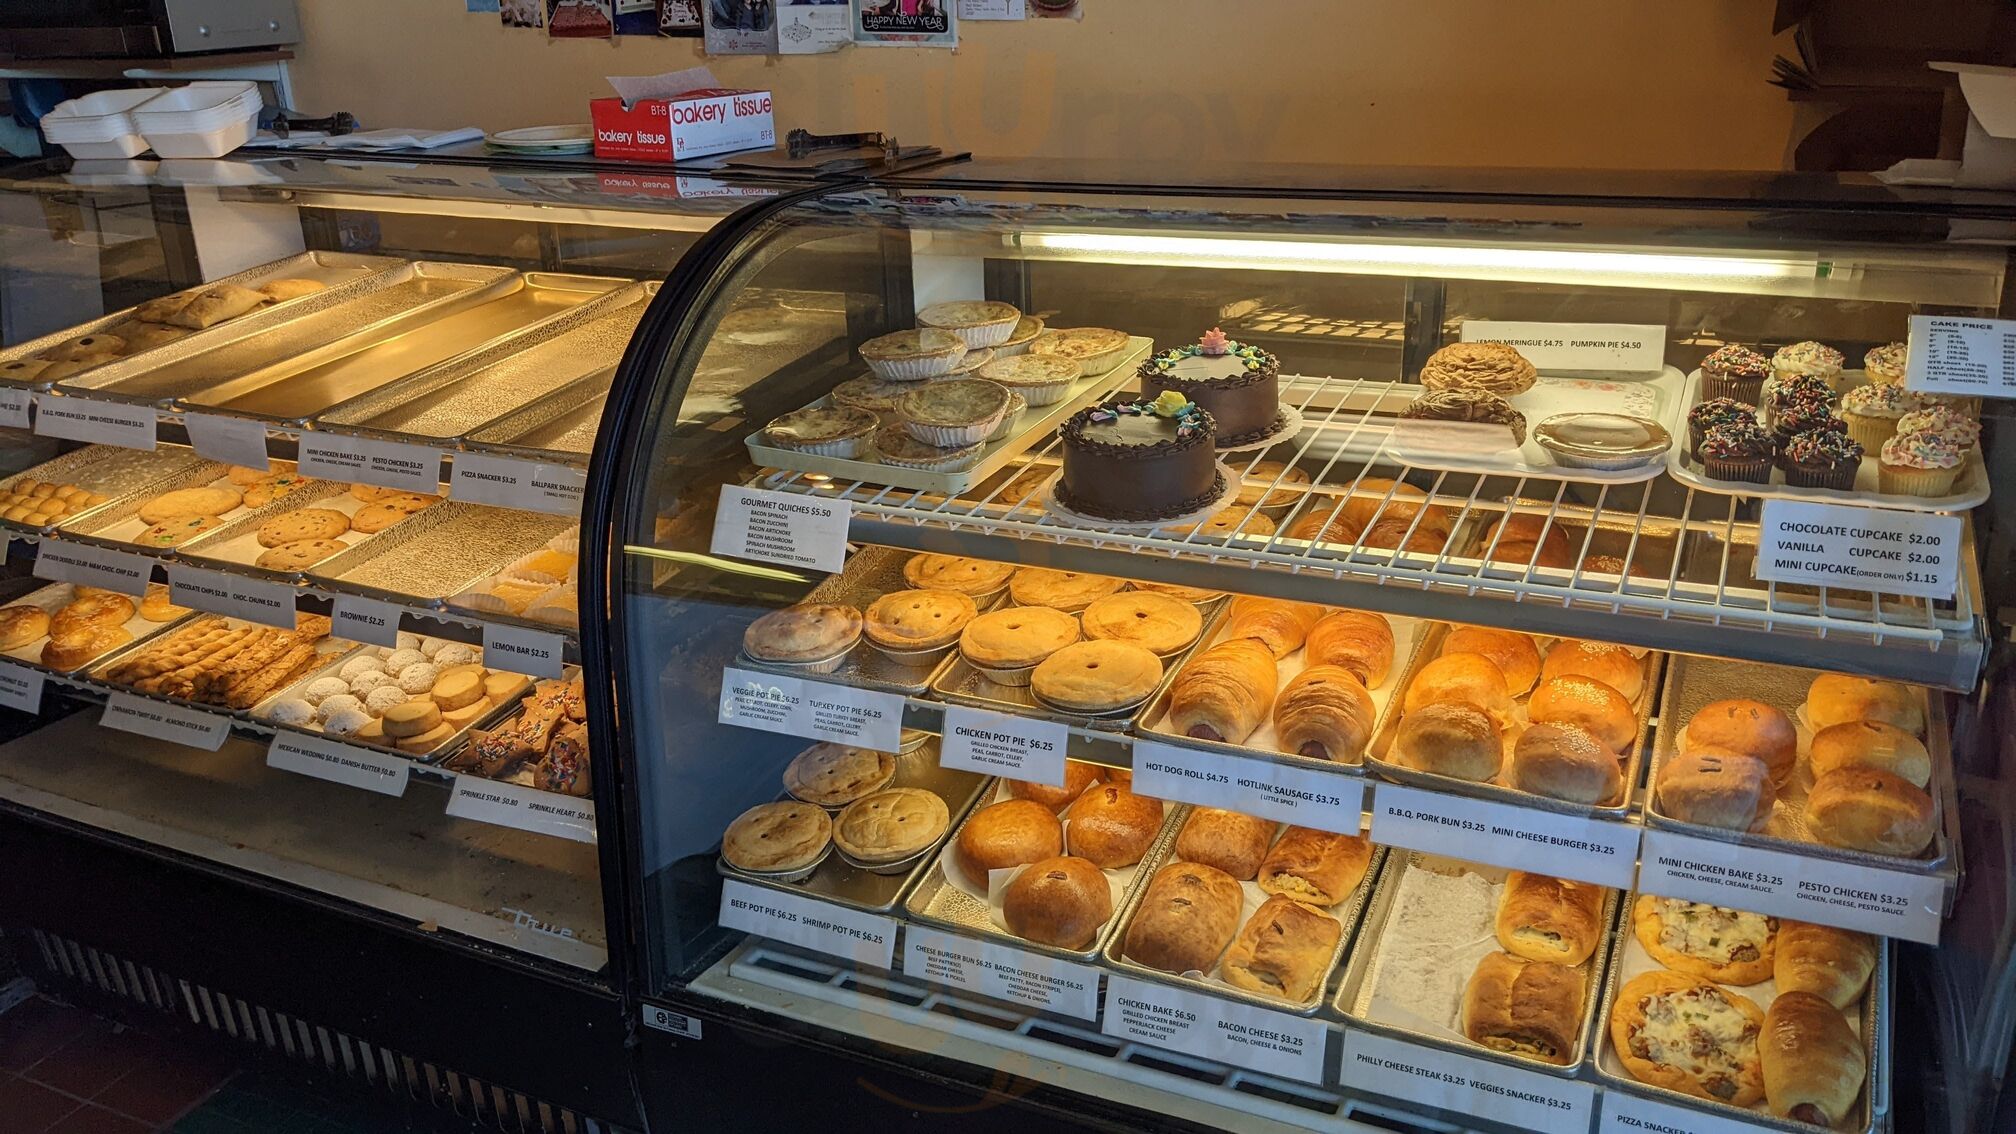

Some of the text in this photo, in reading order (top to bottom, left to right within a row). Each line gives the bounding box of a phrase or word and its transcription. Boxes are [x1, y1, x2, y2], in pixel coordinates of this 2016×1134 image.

[865, 16, 894, 27] HAPPY
[896, 14, 917, 25] NEW
[919, 16, 943, 27] YEAR
[651, 105, 666, 116] BT-8
[672, 96, 771, 124] bakery tissue
[598, 129, 665, 145] bakery tissue
[761, 130, 773, 141] BT-8
[1503, 339, 1542, 347] MERINGUE
[1620, 341, 1641, 349] $4.50
[319, 450, 339, 458] CHICKEN
[388, 459, 409, 467] CHICKEN
[477, 473, 501, 482] SNACKER
[502, 476, 516, 484] $3.25
[531, 481, 558, 490] BALLPARK
[741, 498, 831, 517] GOURMET QUICHES $5.50
[767, 512, 788, 520] SPINACH
[765, 527, 791, 536] ARTICHOKE
[767, 519, 788, 528] ZUCCHINI
[765, 535, 793, 544] MUSHROOM
[1780, 522, 1940, 546] CHOCOLATE CUPCAKE $2.00
[746, 540, 795, 552] SPINACH MUSHROOM
[1777, 541, 1940, 565] VANILLA CUPCAKE $2.00
[745, 548, 769, 556] ARTICHOKE
[795, 555, 816, 563] TOMATO
[1775, 559, 1801, 570] MINI
[1906, 571, 1937, 584] $1.15
[340, 610, 385, 626] BROWNIE $2.25
[492, 641, 549, 659] LEMON BAR $2.25
[732, 686, 754, 697] VEGGIE
[771, 694, 780, 702] PIE
[810, 700, 882, 718] TURKEY POT PIE $6.25
[956, 727, 1053, 751] CHICKEN POT PIE $6.25
[1146, 762, 1229, 784] HOT DOG ROLL $4.75
[1237, 778, 1340, 806] HOTLINK SAUSAGE $3.75
[460, 789, 485, 800] SPRINKLE
[502, 798, 519, 806] $0.80
[528, 803, 556, 813] SPRINKLE
[556, 808, 575, 817] HEART
[1389, 807, 1615, 855] B.B.Q. PORK BUN $3.25 MINI CHEESE BURGER $3.25
[1658, 856, 1783, 886] MINI CHICKEN BAKE $3.25
[1667, 870, 1774, 894] CHICKEN, CHEESE, CREAM SAUCE.
[1796, 892, 1827, 904] CHICKEN,
[1829, 897, 1856, 909] CHEESE,
[1858, 902, 1880, 912] PESTO
[1798, 881, 1908, 907] PESTO CHICKEN $3.25
[731, 899, 883, 944] BEEF POT PIE $6.25 SHRIMP POT PIE $6.25
[916, 945, 936, 955] CHEESE
[937, 950, 961, 961] BURGER
[962, 955, 975, 963] BUN
[976, 958, 992, 968] $6.25
[995, 964, 1016, 975] BACON
[1017, 968, 1039, 980] CHEESE
[1040, 974, 1065, 986] BURGER
[1066, 979, 1084, 990] $6.25
[1118, 997, 1196, 1022] CHICKEN BAKE $6.50
[1122, 1009, 1189, 1029] GRILLED CHICKEN BREAST
[1123, 1017, 1176, 1034] PEPPERJACK CHEESE
[1129, 1027, 1167, 1041] CREAM SAUCE
[1218, 1021, 1303, 1046] BACON CHEESE $3.25
[1227, 1034, 1249, 1045] BACON,
[1250, 1039, 1272, 1049] CHEESE
[1278, 1045, 1302, 1056] ONIONS
[1357, 1053, 1572, 1111] PHILLY CHEESE STEAK $3.25 VEGGIES SNACKER $3.25
[1617, 1114, 1642, 1127] PIZZA
